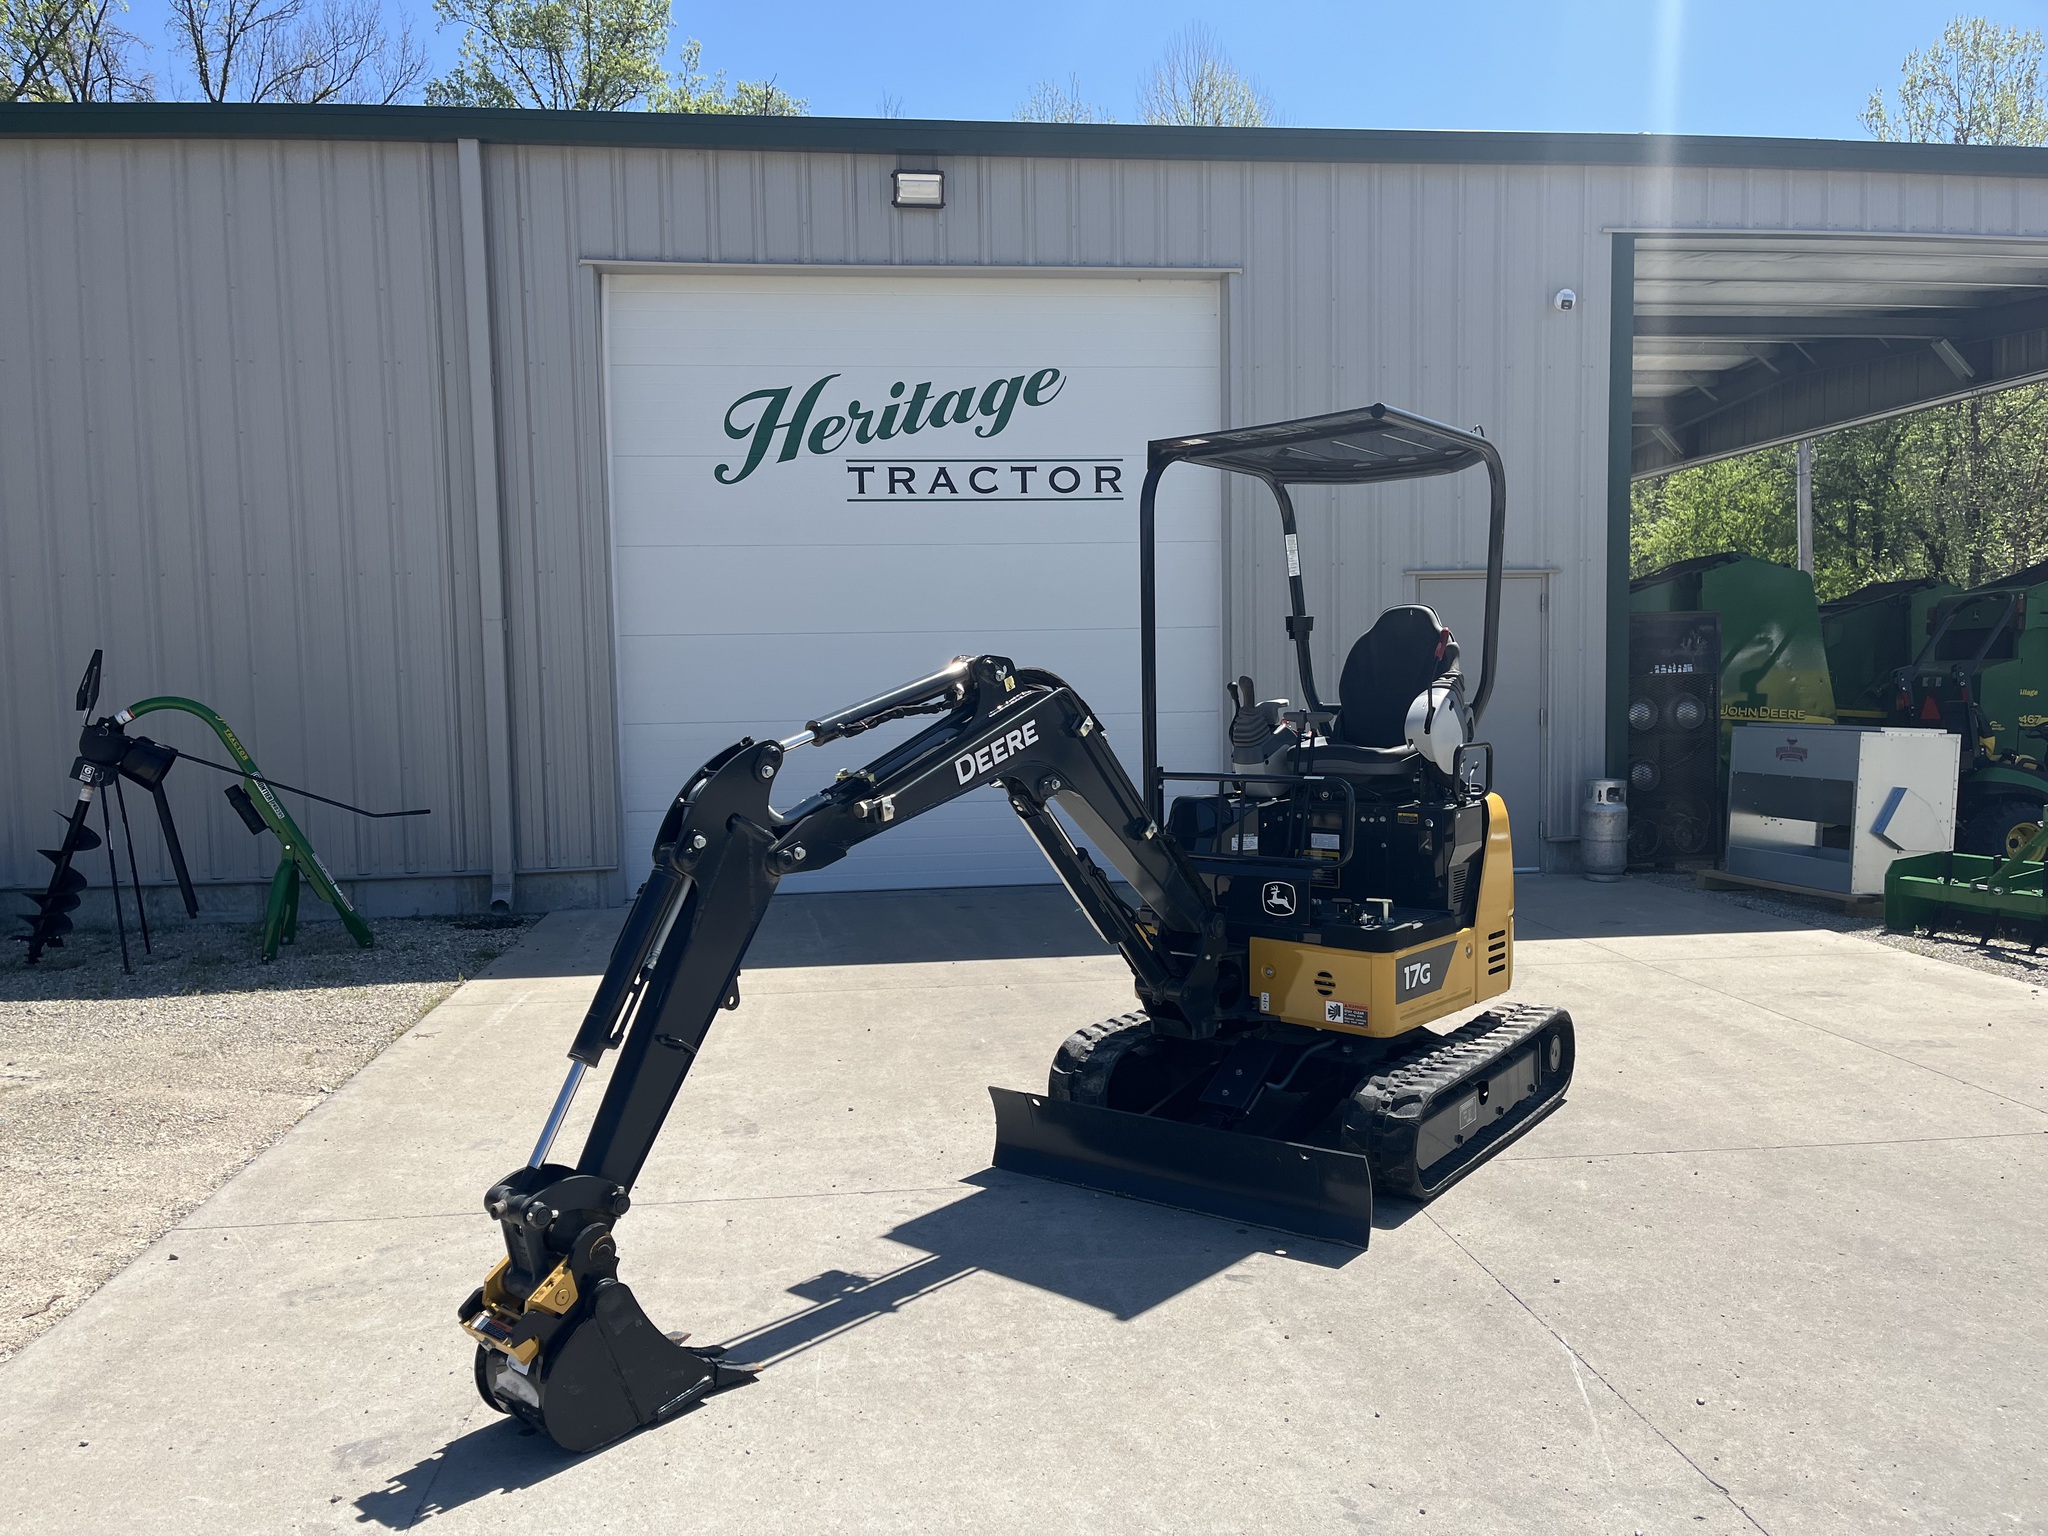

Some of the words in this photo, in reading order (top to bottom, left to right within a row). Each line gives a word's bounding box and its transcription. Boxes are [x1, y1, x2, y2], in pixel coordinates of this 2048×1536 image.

[713, 367, 1068, 485] Heritage
[846, 465, 1123, 495] TRACTOR
[1720, 704, 1758, 718] JOHN
[1759, 706, 1806, 719] DEERE
[2020, 714, 2042, 724] 467
[224, 728, 249, 761] TRACTOR
[954, 719, 1040, 786] DEERE
[1403, 962, 1431, 990] 17G
